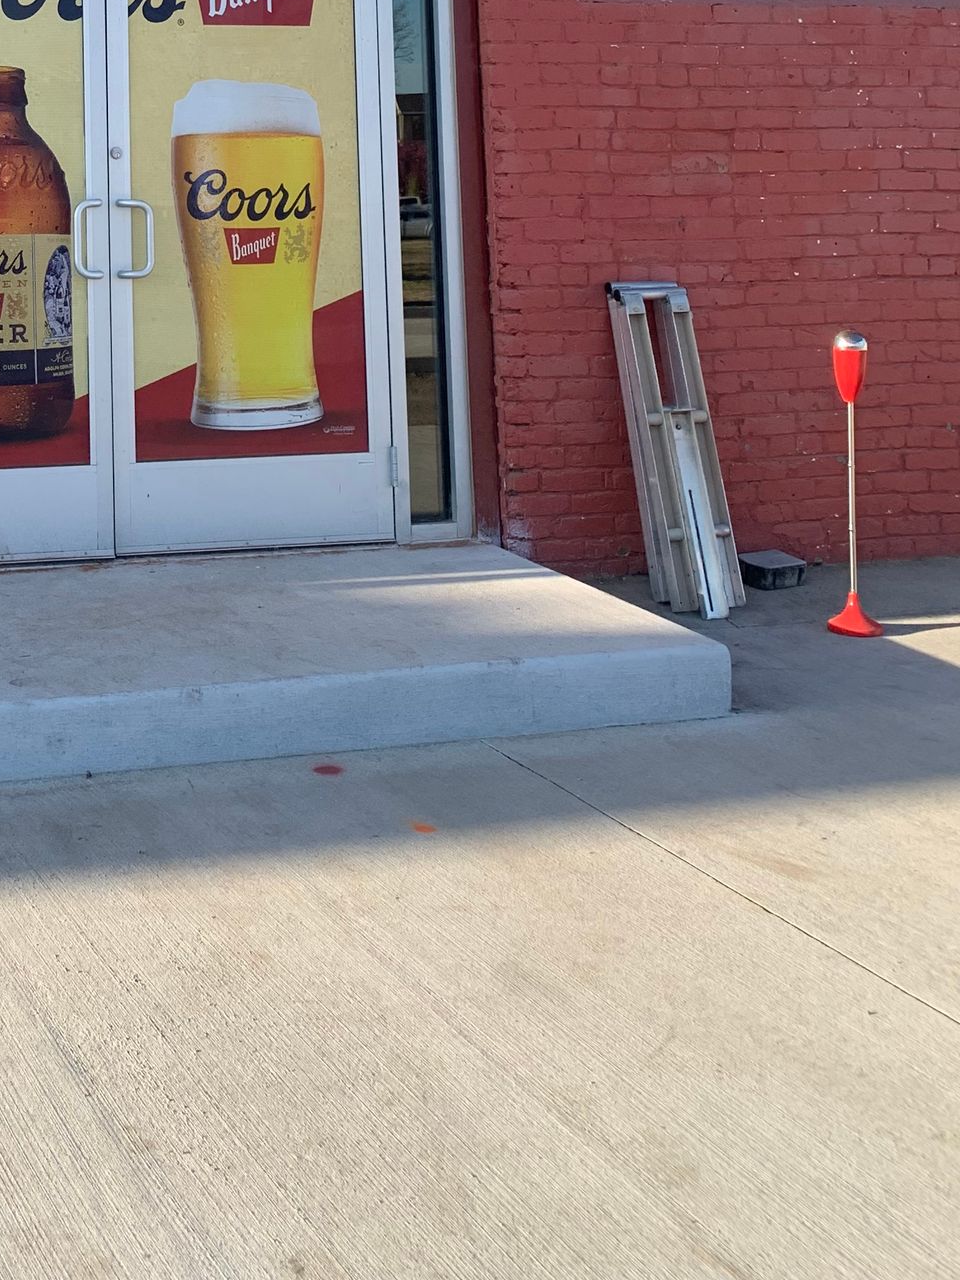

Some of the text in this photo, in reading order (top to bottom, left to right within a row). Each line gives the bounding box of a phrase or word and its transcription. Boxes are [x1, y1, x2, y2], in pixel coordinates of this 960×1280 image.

[184, 169, 316, 221] Coors
[231, 231, 277, 261] Banquet
[2, 363, 28, 371] OUNCES
